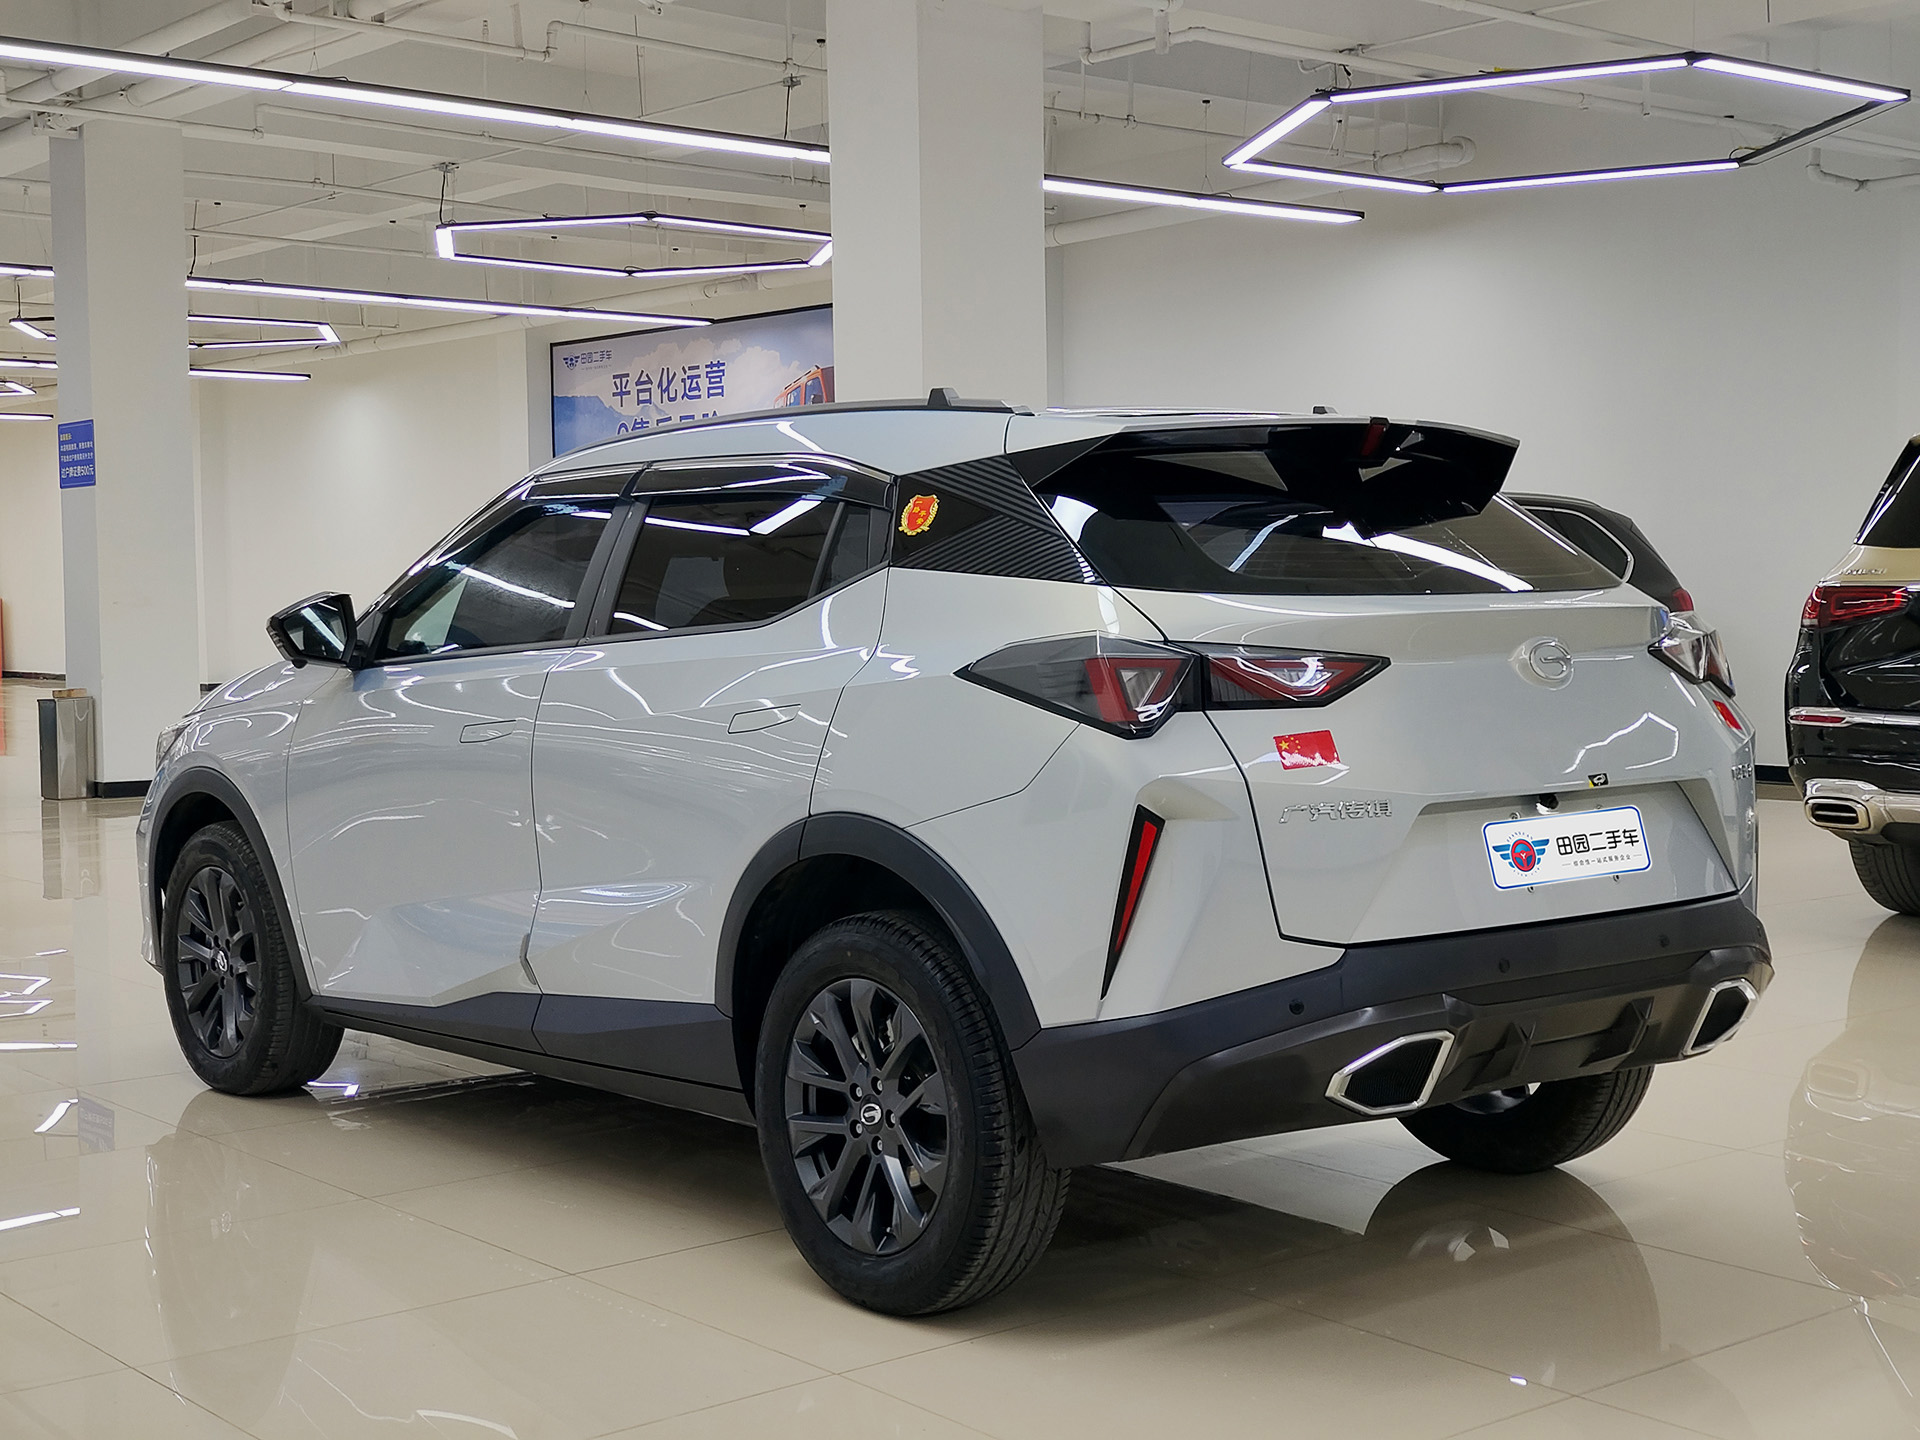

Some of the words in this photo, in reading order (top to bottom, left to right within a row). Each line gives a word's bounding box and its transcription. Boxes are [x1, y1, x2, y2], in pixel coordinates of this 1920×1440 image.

[612, 360, 726, 407] 平台化运营
[1279, 800, 1392, 824] 广汽传祺
[1556, 829, 1639, 856] 田园二手车
